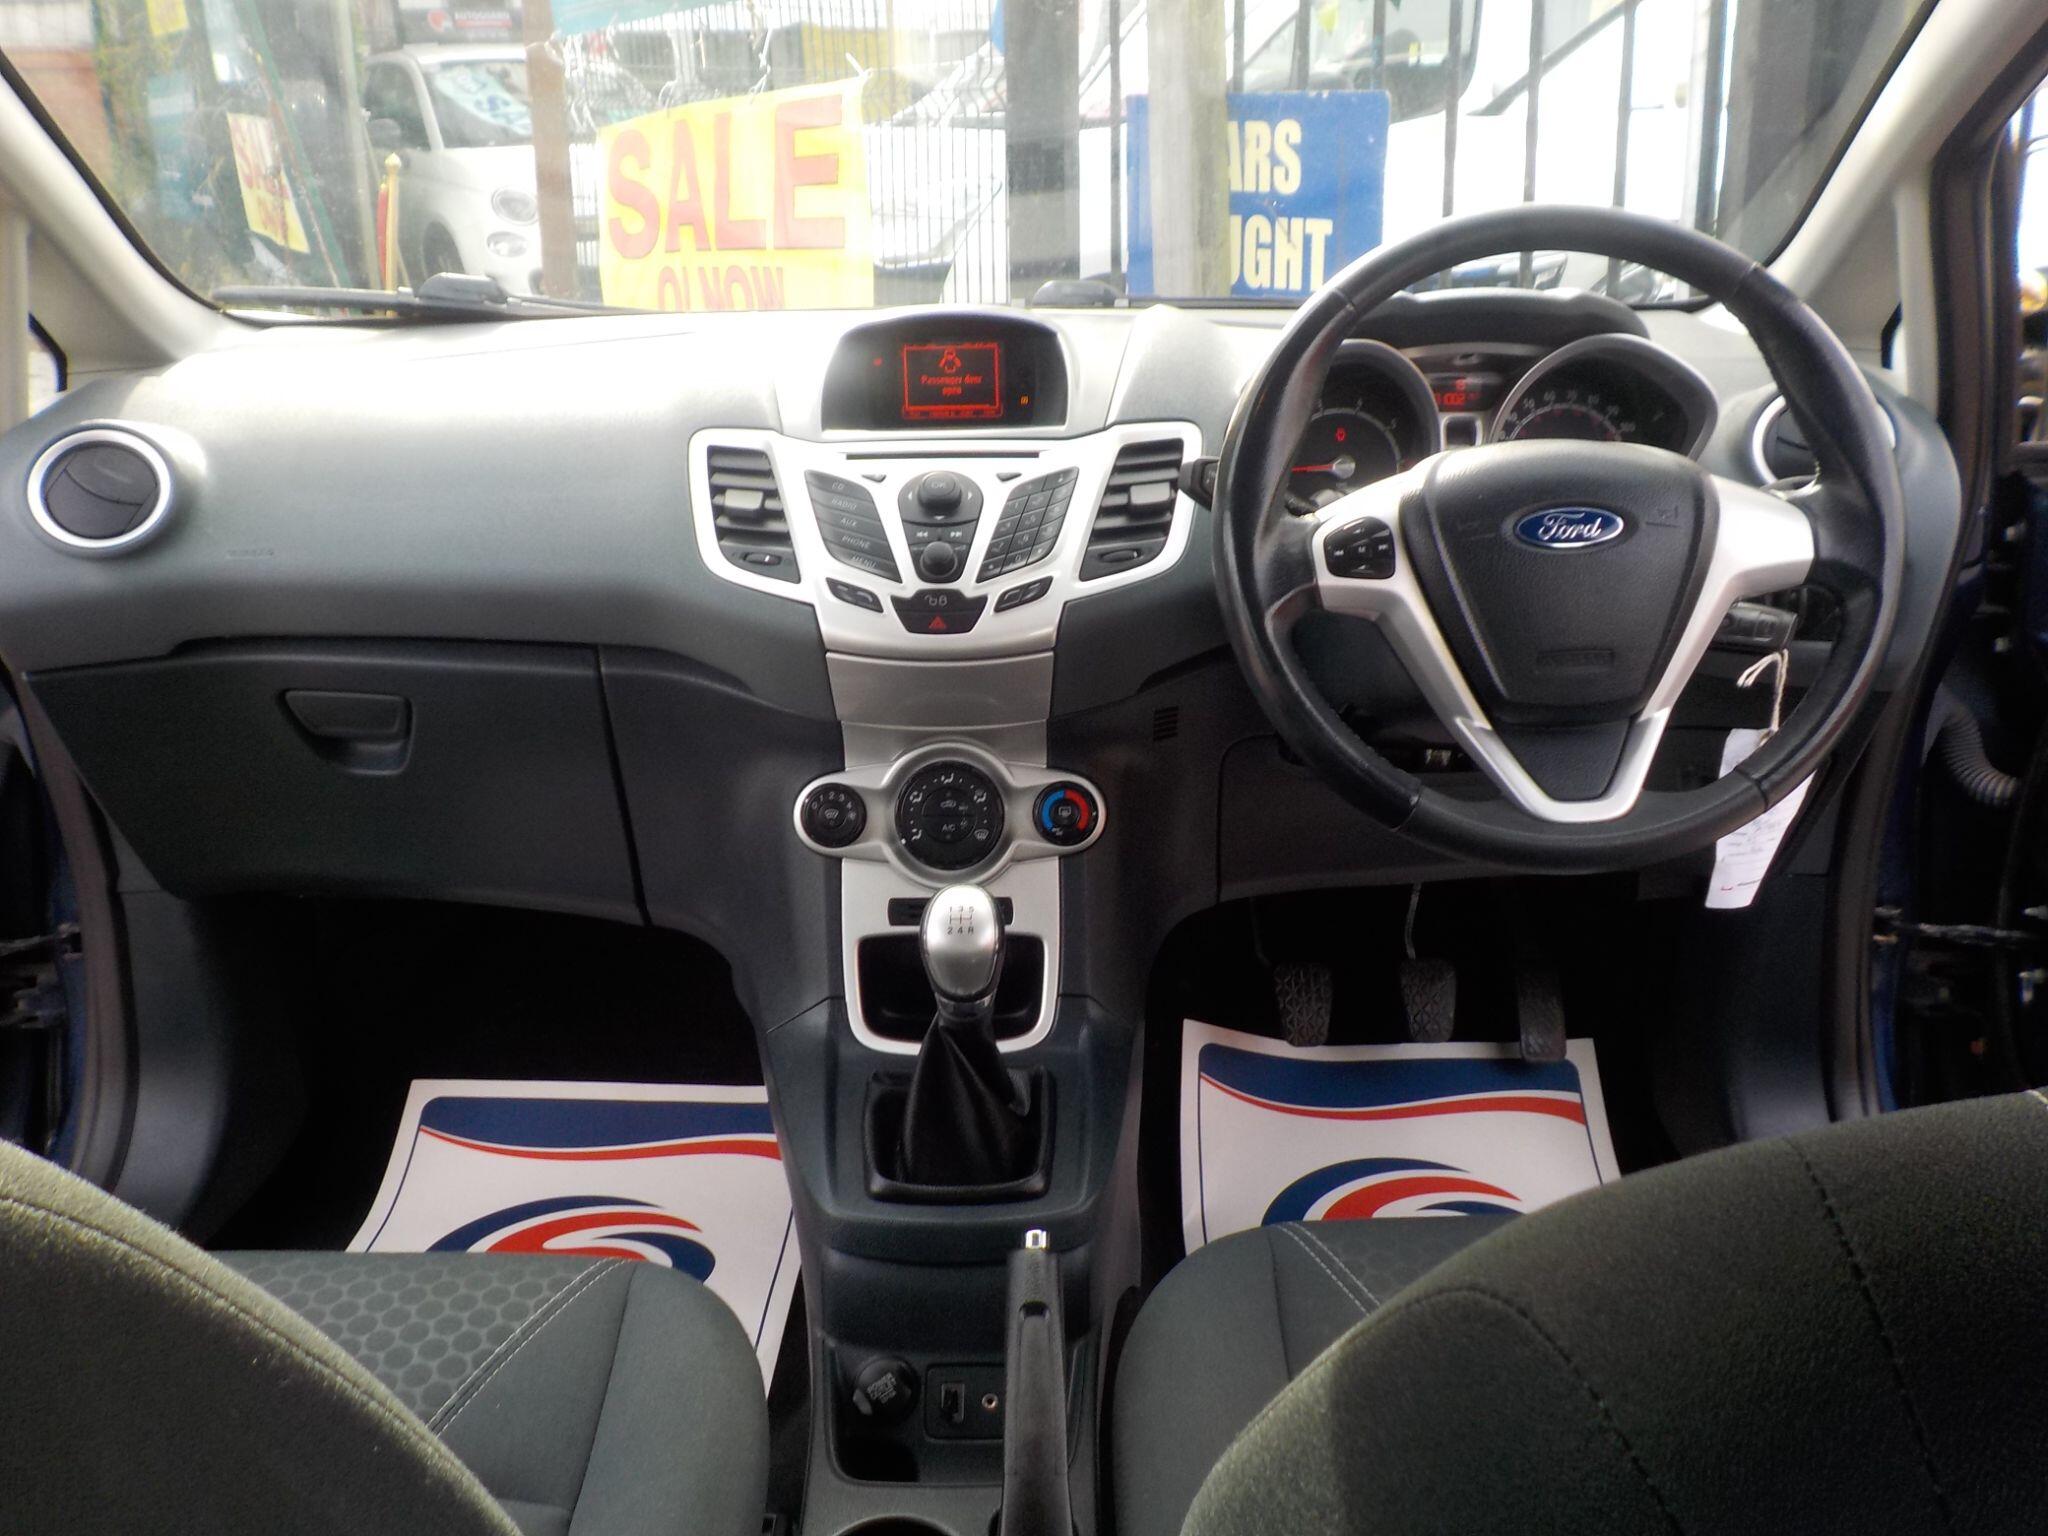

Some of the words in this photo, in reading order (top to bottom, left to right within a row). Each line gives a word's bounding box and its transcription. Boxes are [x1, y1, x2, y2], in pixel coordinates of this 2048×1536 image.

[1228, 119, 1302, 195] ARS
[608, 94, 845, 260] SALE
[1230, 214, 1333, 292] UGHT
[697, 265, 786, 311] NOW
[832, 497, 858, 511] RADIO
[841, 517, 857, 527] AUX
[1538, 512, 1603, 541] Ford
[842, 535, 871, 549] PHONE
[829, 791, 835, 800] 2
[947, 926, 953, 935] 2
[957, 926, 963, 934] 4
